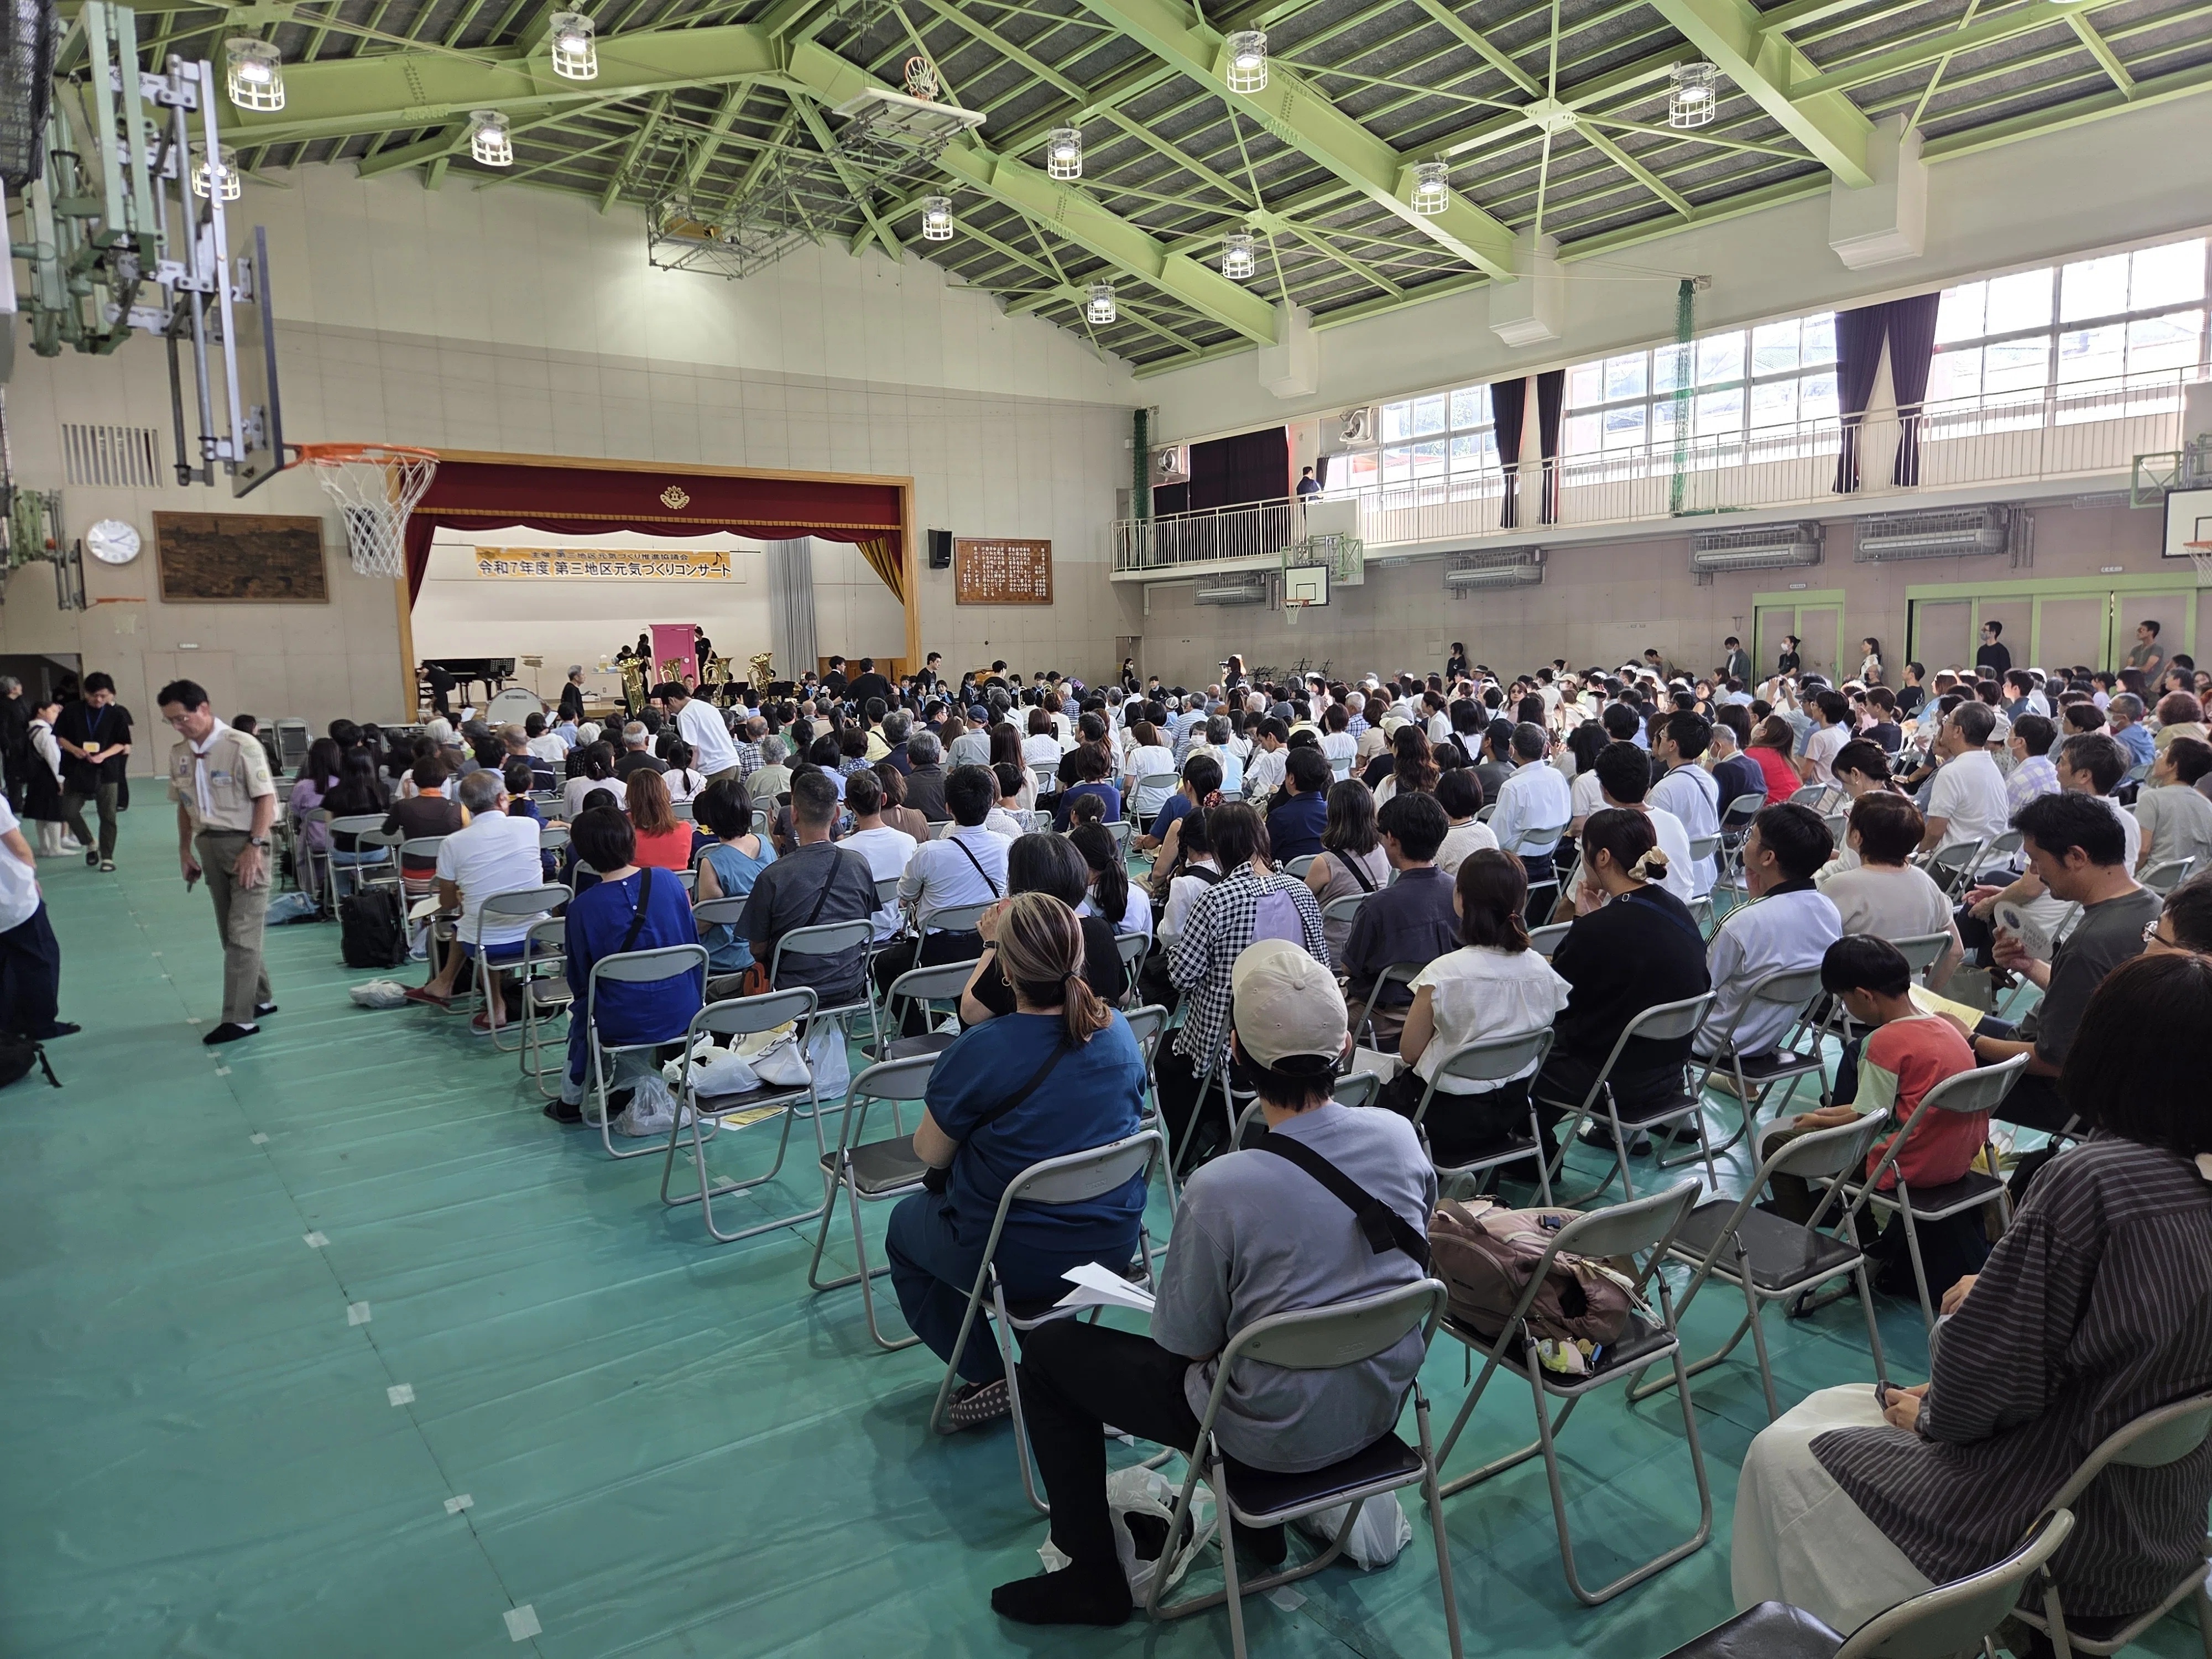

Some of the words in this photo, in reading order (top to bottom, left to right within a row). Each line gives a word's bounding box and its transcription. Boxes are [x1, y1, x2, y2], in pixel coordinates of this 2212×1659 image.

[478, 560, 550, 575] 令和7年度
[555, 561, 731, 577] 第三地区元気づくりコンサート
